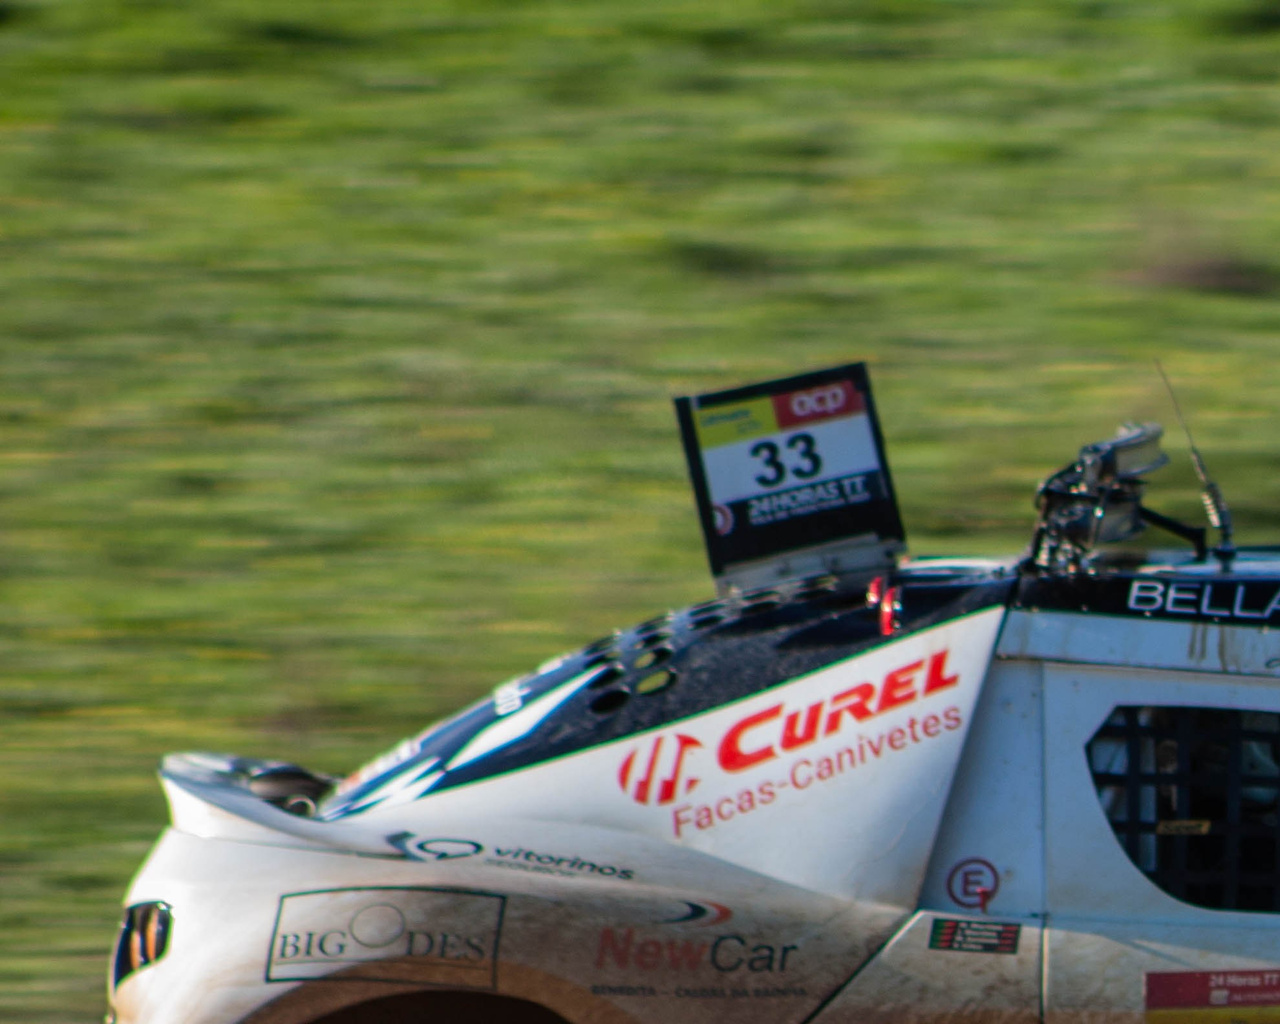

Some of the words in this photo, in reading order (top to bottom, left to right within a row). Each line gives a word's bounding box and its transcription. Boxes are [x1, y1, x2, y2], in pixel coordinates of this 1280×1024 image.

[748, 431, 824, 489] 33
[671, 705, 964, 839] Facas-Canivetes
[494, 846, 635, 881] vitorinos
[594, 924, 799, 973] NewCar
